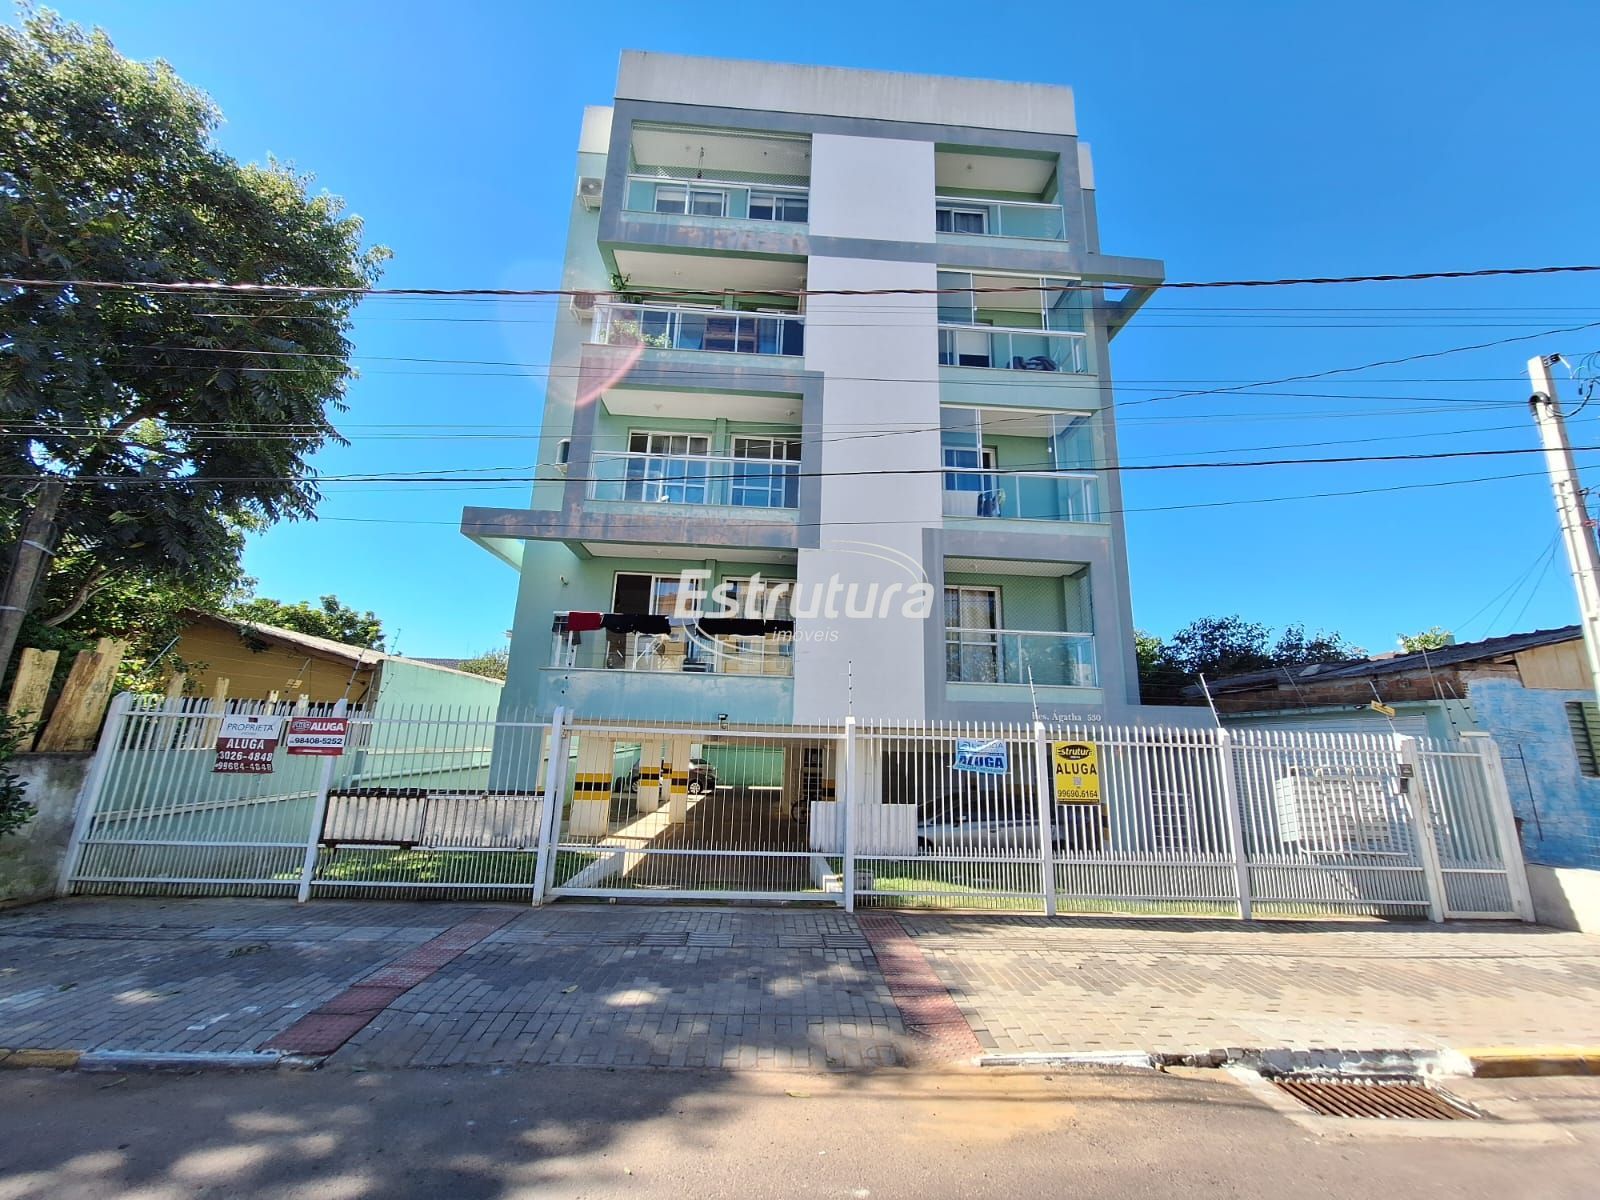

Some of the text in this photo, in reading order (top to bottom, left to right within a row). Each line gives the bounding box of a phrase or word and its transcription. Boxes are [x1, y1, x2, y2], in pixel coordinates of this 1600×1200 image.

[310, 722, 344, 732] ALUGA
[226, 738, 265, 750] ALUGA
[294, 737, 343, 745] 98408-5252
[218, 750, 273, 762] 3026-4848
[958, 755, 1005, 769] ALUGA
[1056, 763, 1097, 775] ALUGA
